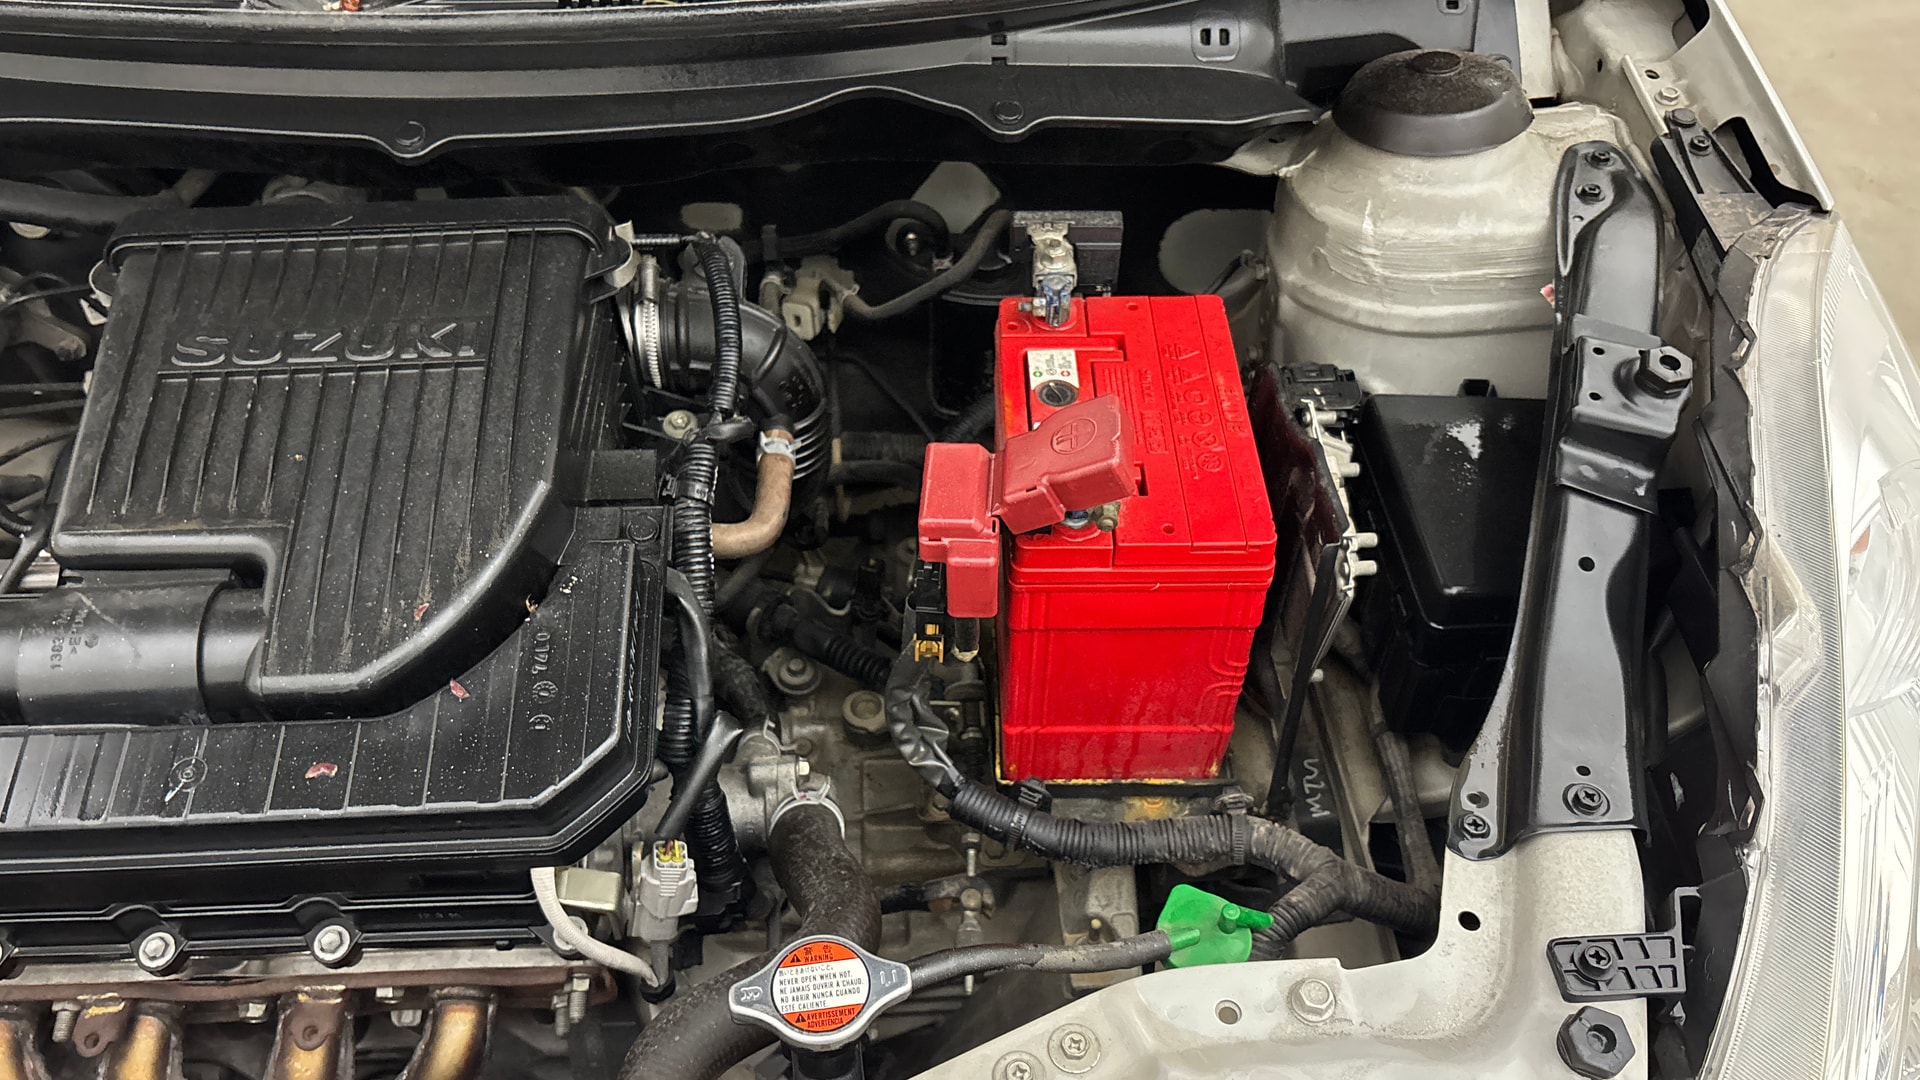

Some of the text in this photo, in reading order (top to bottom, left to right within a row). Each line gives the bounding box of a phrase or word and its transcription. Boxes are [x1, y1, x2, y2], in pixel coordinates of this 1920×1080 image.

[170, 322, 478, 367] SUZUKI
[804, 953, 834, 963] WARNING
[779, 977, 799, 986] NEVER
[801, 974, 817, 984] OPEN
[820, 972, 837, 981] WHEN
[780, 987, 787, 995] NE
[789, 985, 811, 994] JAMAIS
[780, 987, 861, 1004] NO ABRIR NUNCA CUANDO
[781, 1004, 795, 1013] ESTE
[806, 1007, 856, 1020] AVERTISSEMENT
[807, 1017, 844, 1029] ADVERTENCIA
